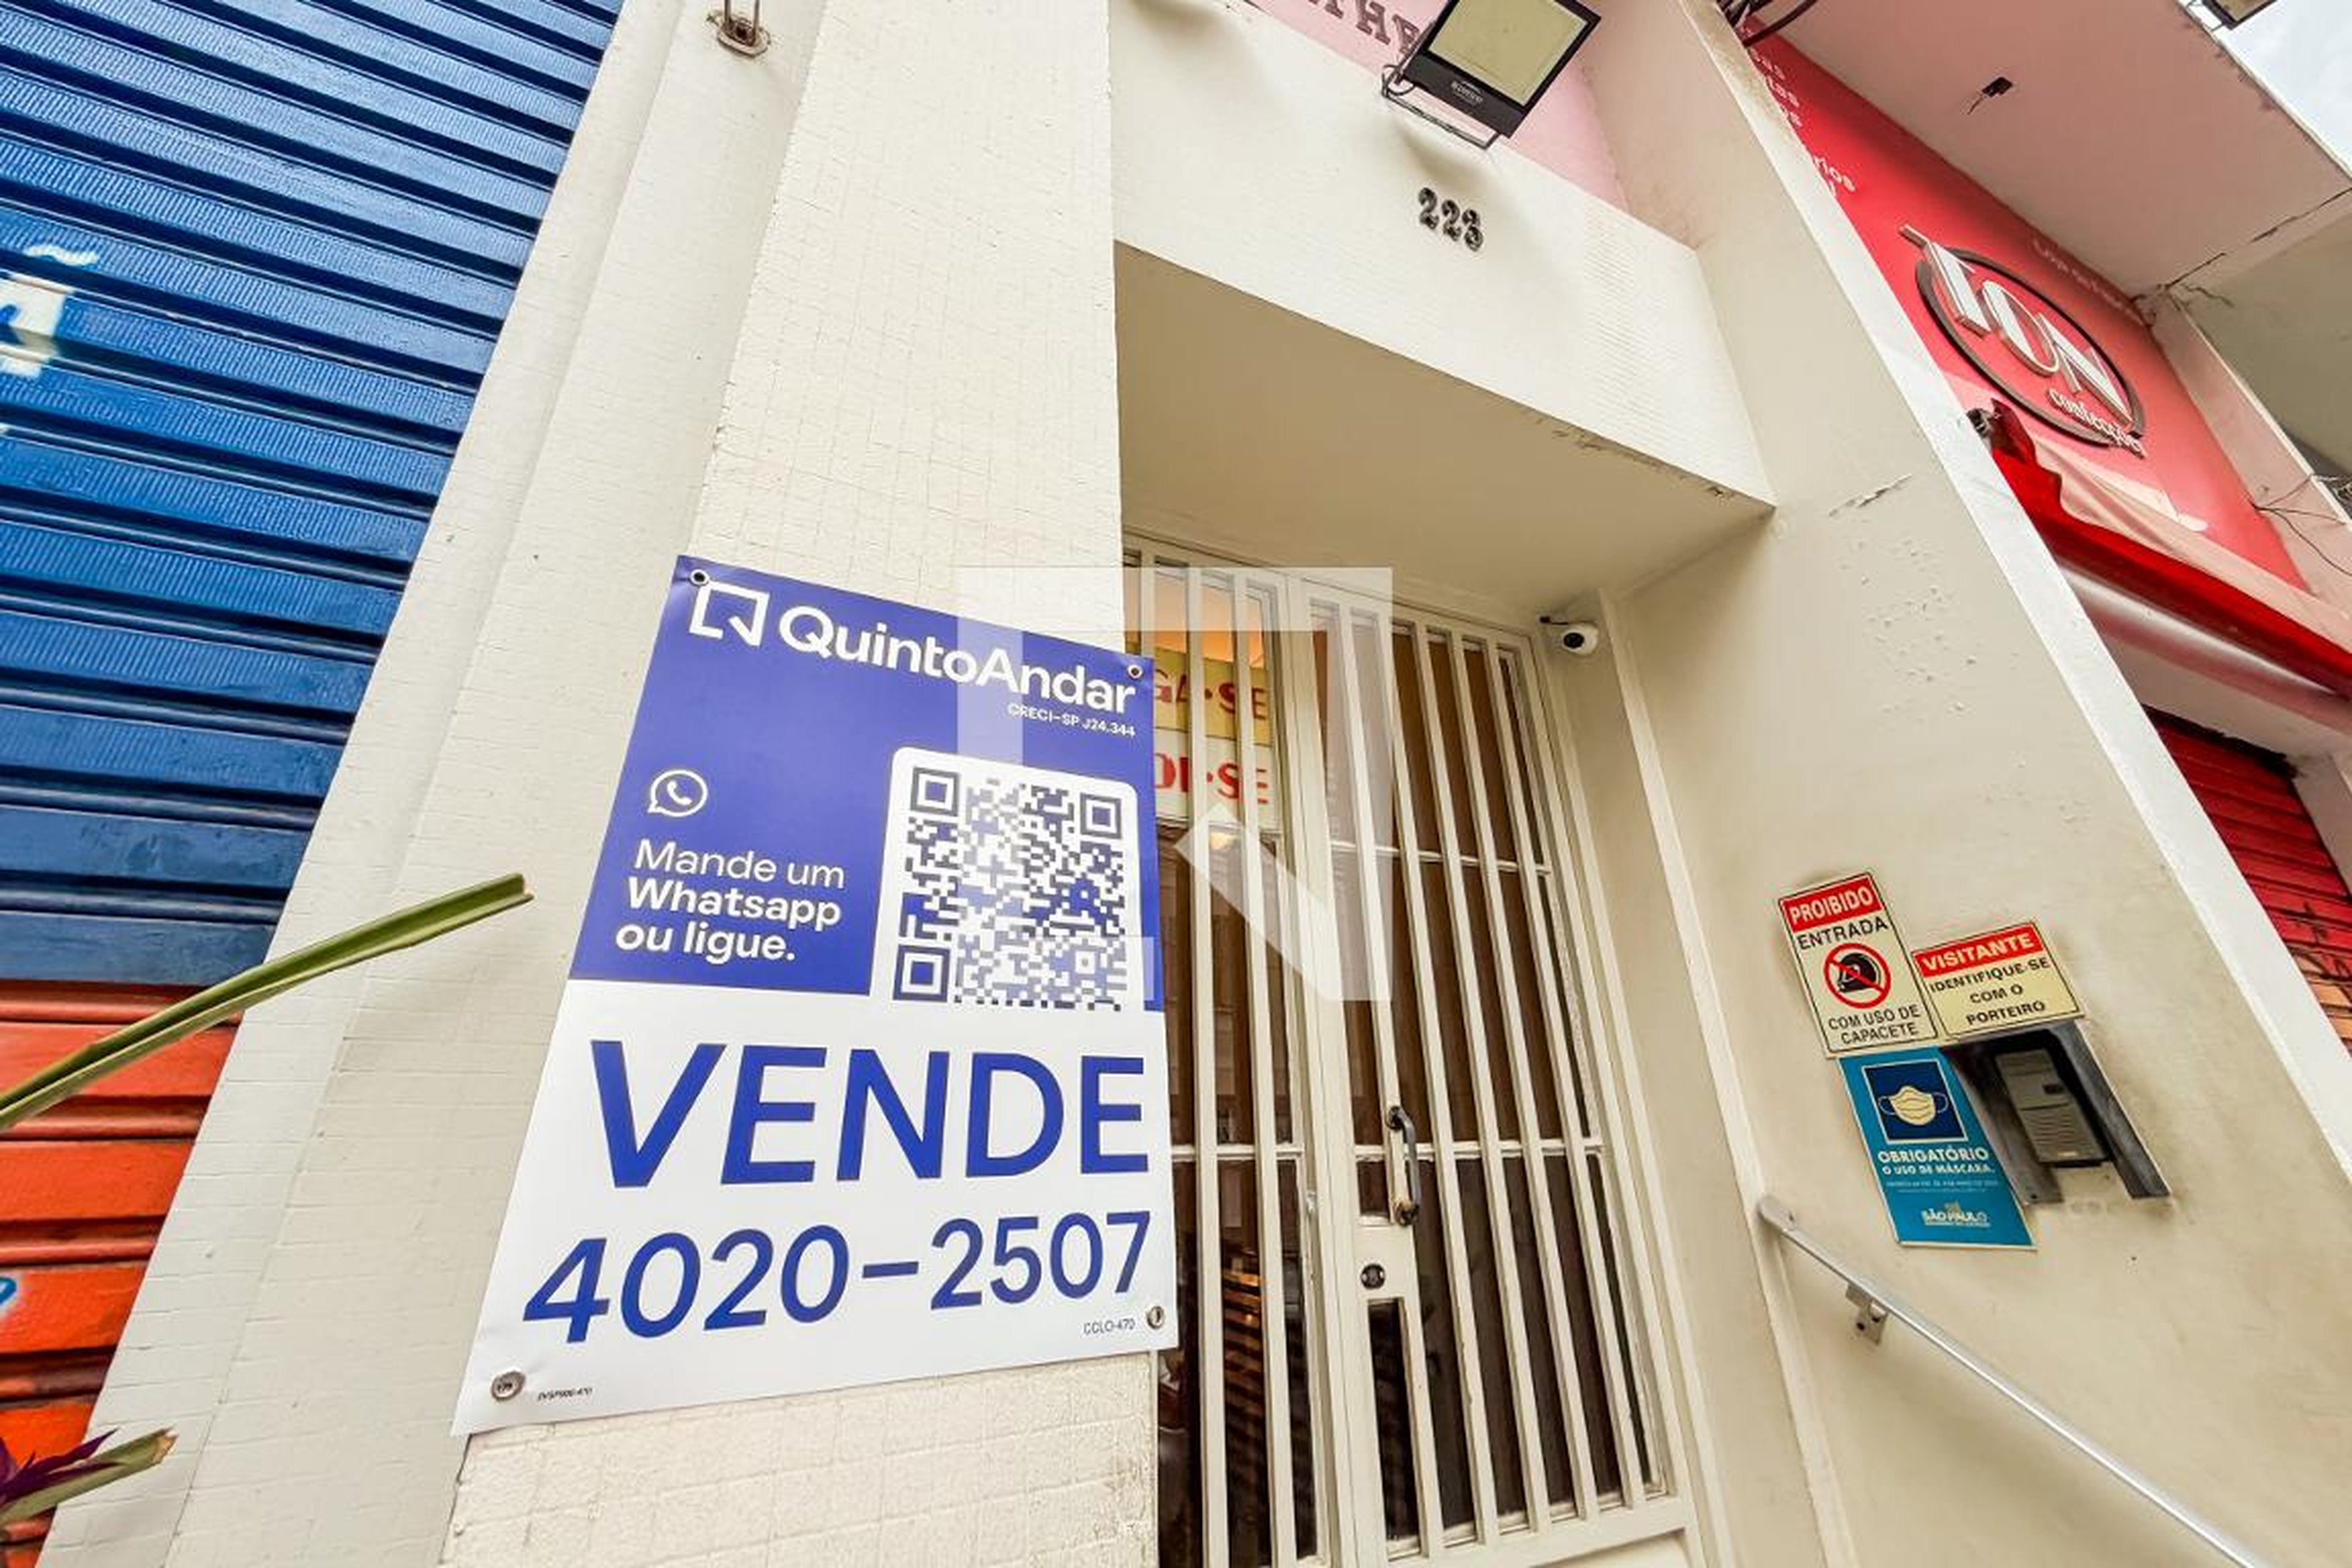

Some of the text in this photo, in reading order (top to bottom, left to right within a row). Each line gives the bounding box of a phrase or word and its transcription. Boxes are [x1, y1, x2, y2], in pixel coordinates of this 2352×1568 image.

[1417, 186, 1484, 252] 223
[778, 605, 1136, 714] QuintoAndar
[1007, 703, 1136, 737] CRECI-SP J24.344
[635, 839, 845, 889] Mande um
[627, 876, 842, 932] Whatsapp
[1789, 886, 1874, 925] PROIBIDO
[616, 921, 796, 965] ou ligue.
[1796, 916, 1889, 950] ENTRADA
[1922, 932, 2035, 973] VISITANTE
[1929, 957, 2050, 993] IDENTIFIQUE-SE
[1969, 983, 2024, 1005] COM O
[1828, 1004, 1921, 1031] COM USO DE
[1966, 1000, 2046, 1026] PORTEIRO
[1841, 1022, 1920, 1045] CAPACETE
[590, 1040, 1150, 1188] VENDE
[1877, 1145, 1990, 1164] OBRIGATÓRIO
[521, 1210, 1151, 1344] 4020-2507
